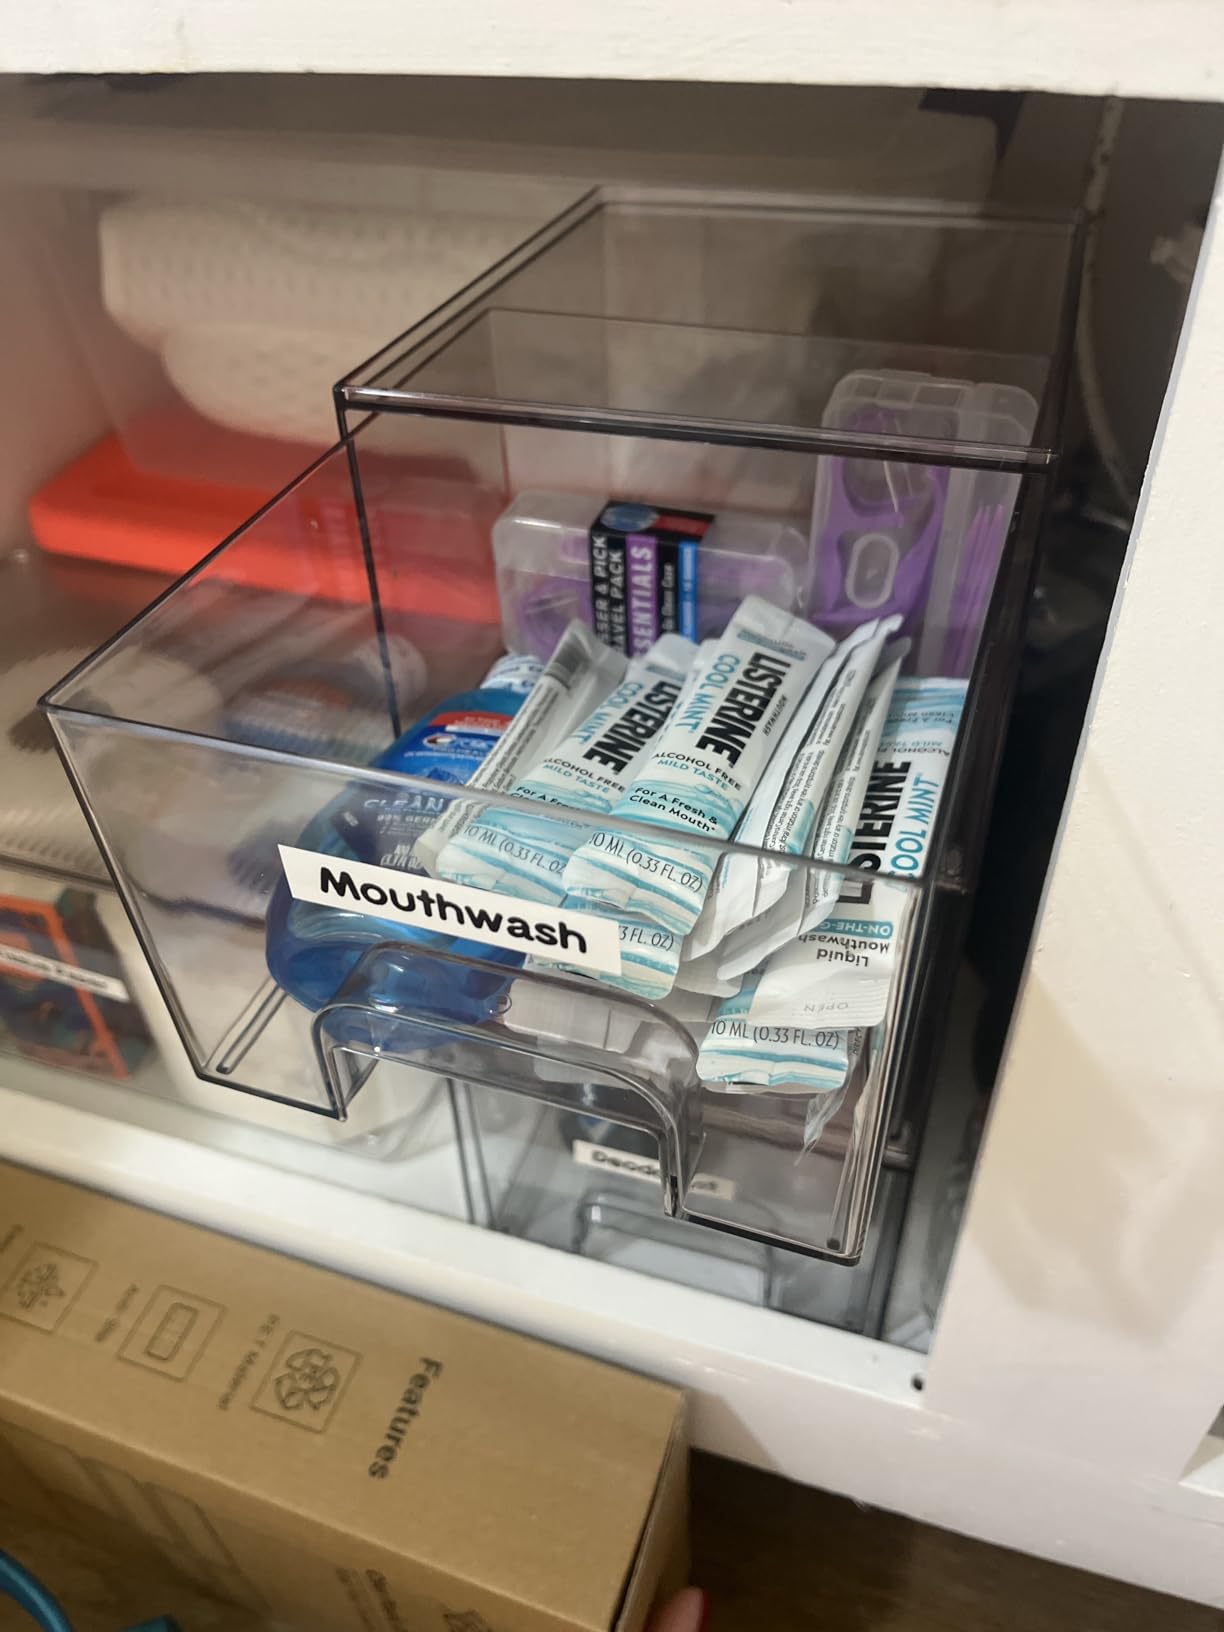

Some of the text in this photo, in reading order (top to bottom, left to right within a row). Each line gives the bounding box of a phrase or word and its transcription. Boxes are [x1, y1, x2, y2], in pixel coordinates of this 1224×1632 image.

[593, 536, 608, 577] PICK
[609, 551, 625, 652] AVEL PACK
[630, 545, 654, 656] SENTIALS
[572, 682, 644, 743] COOL MINT
[674, 653, 741, 735] COOL MINT
[695, 652, 792, 767] LISTERINE
[582, 680, 683, 776] LISTERINE
[542, 763, 611, 794] MILD TASTE
[543, 757, 626, 793] ALCOHOL FREE
[653, 750, 743, 791] ALCOHOL FREE
[656, 758, 729, 791] MILD TASTE
[516, 785, 537, 798] For
[629, 794, 667, 815] Clean
[634, 786, 719, 826] For A Fresh &
[836, 760, 912, 905] LSTERINE
[887, 772, 940, 878] OOL MINT
[476, 826, 497, 847] ML
[498, 832, 530, 864] (0.33
[530, 850, 547, 871] FL.
[607, 836, 625, 858] ML
[625, 841, 661, 875] (0.33
[660, 859, 678, 884] FL.
[680, 868, 704, 893] OZ)
[318, 866, 588, 954] Mouthwash
[819, 921, 892, 938] ON-THE-G
[629, 928, 650, 945] FL.
[651, 932, 676, 951] OZ)
[797, 933, 890, 954] Mouthwash
[816, 948, 870, 968] Liquid
[711, 1020, 726, 1036] 10
[728, 1021, 749, 1039] ML
[753, 1025, 789, 1044] (0.33
[793, 1028, 812, 1046] FL.
[815, 1030, 840, 1050] OZ)
[367, 1356, 444, 1480] Features
